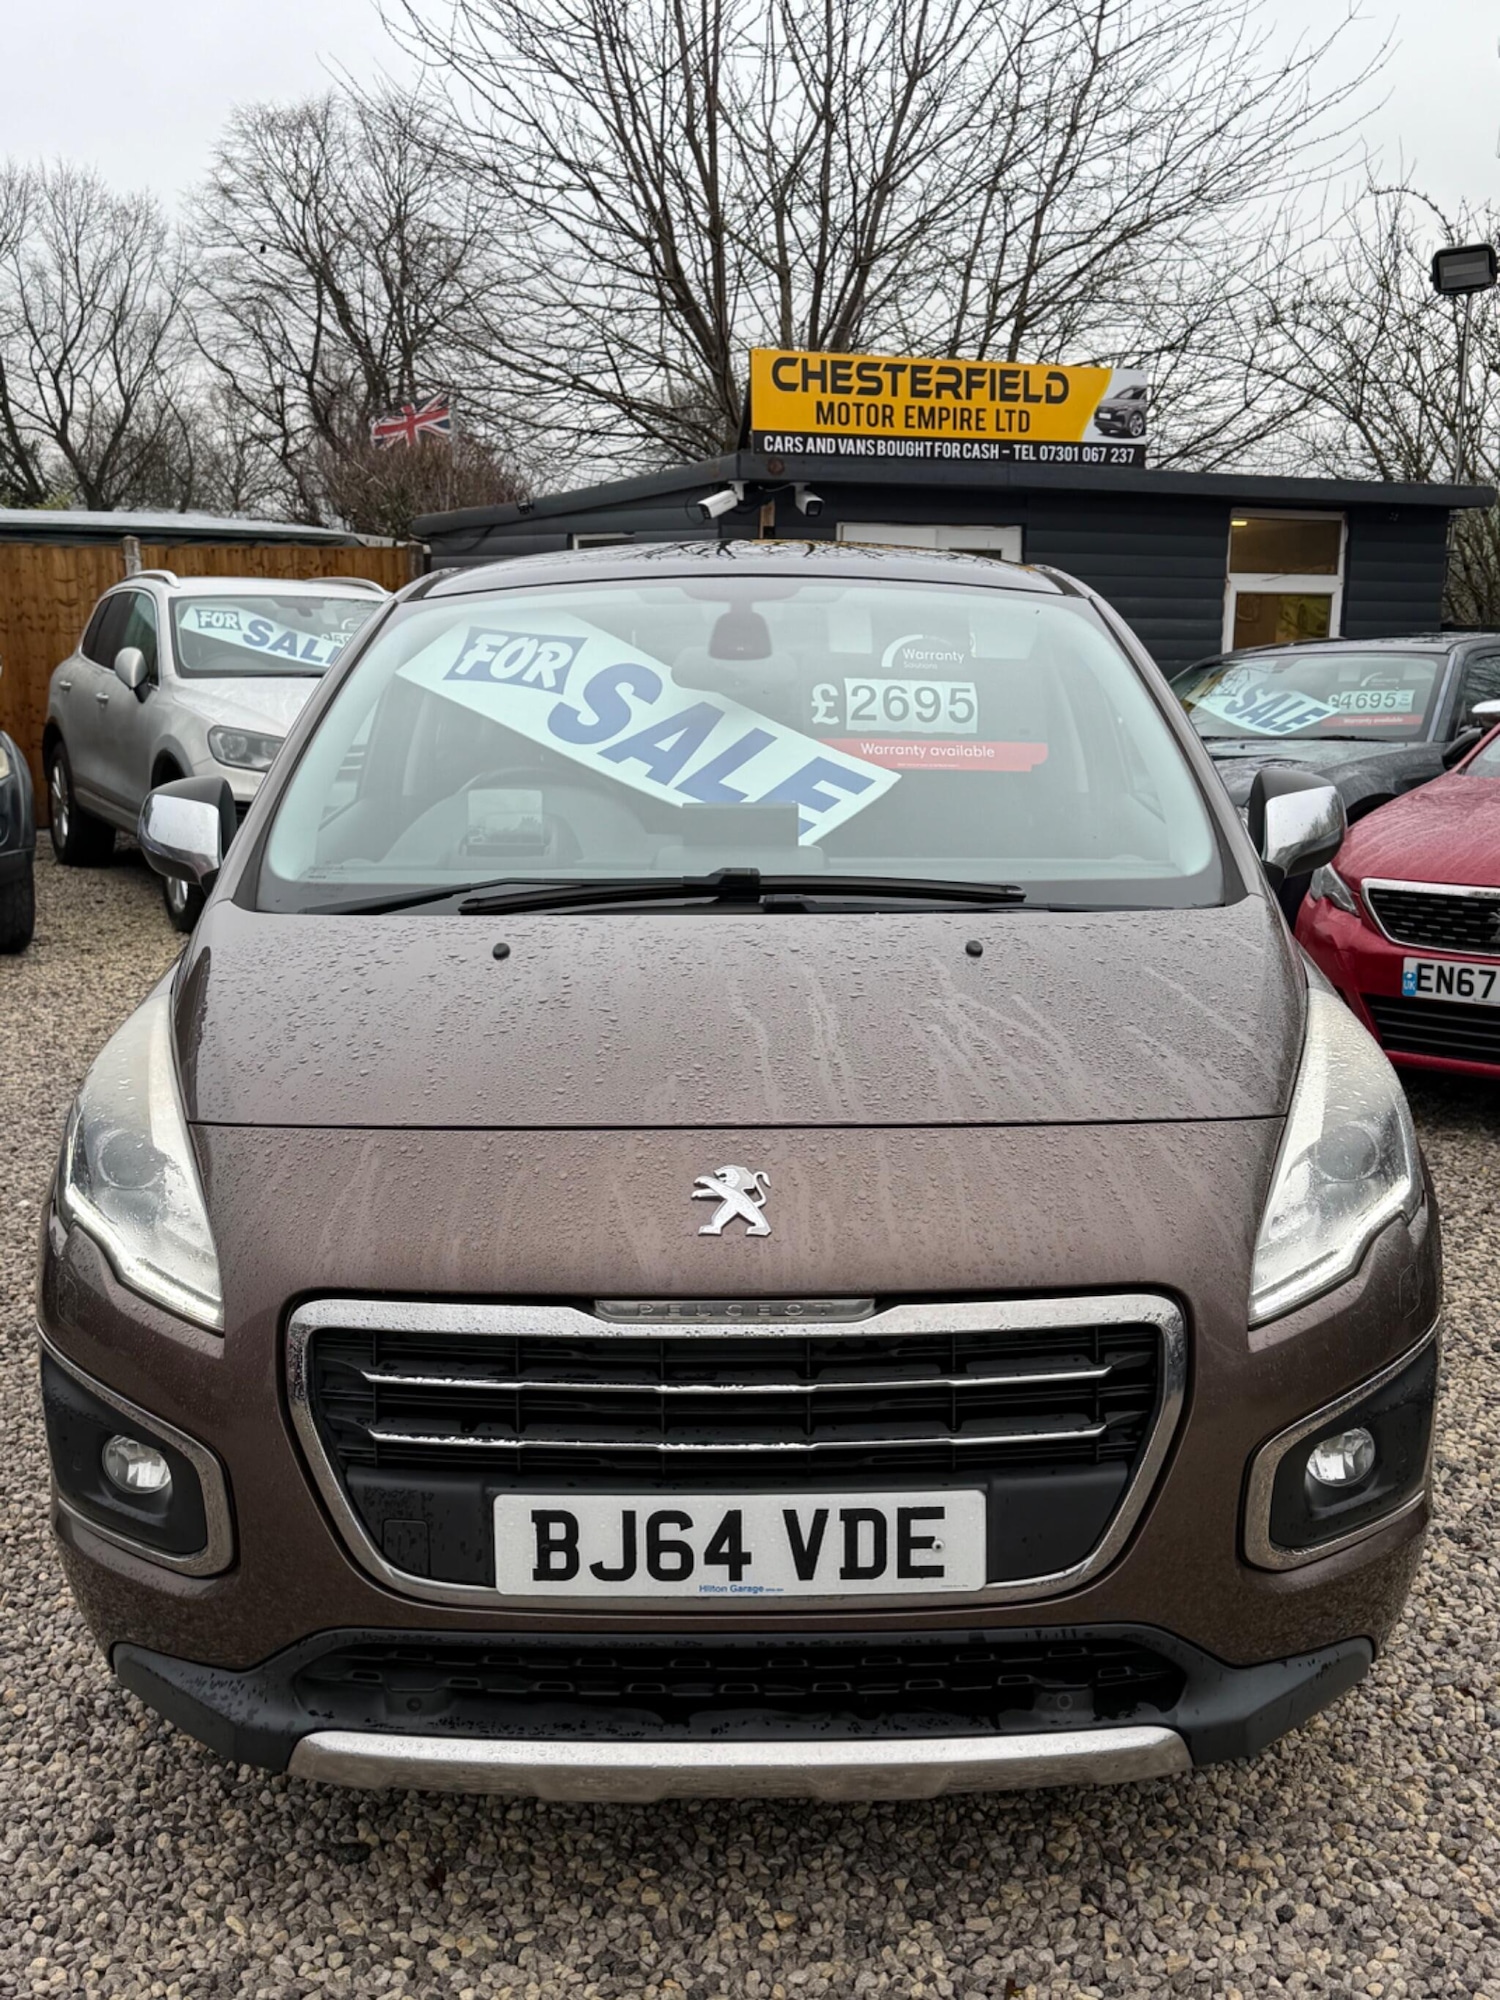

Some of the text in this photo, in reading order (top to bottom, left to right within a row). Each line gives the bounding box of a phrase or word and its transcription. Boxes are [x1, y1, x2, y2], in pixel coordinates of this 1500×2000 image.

[771, 356, 1069, 404] CHESTERFIELD
[815, 400, 1031, 433] MOTOR EMPIRE LTD
[763, 435, 804, 453] CARS
[805, 436, 837, 454] AND
[838, 438, 876, 456] VANS
[876, 439, 933, 458] BOUGHT
[934, 441, 962, 459] FOR
[962, 442, 1000, 460] CASH
[1013, 444, 1037, 461] TEL
[1039, 445, 1079, 462] 07301
[1081, 446, 1107, 463] 067
[1110, 447, 1135, 464] 237
[199, 610, 342, 665] FOR SAL
[902, 647, 965, 664] Warranty
[810, 682, 976, 725] £2695
[1223, 681, 1320, 732] SALE
[455, 632, 876, 838] FOR SALE
[859, 742, 996, 760] Warranty available
[1415, 962, 1497, 999] EN67
[530, 1506, 946, 1583] BJ64 VDE
[698, 1584, 729, 1593] Hilton
[729, 1584, 765, 1594] Garage
